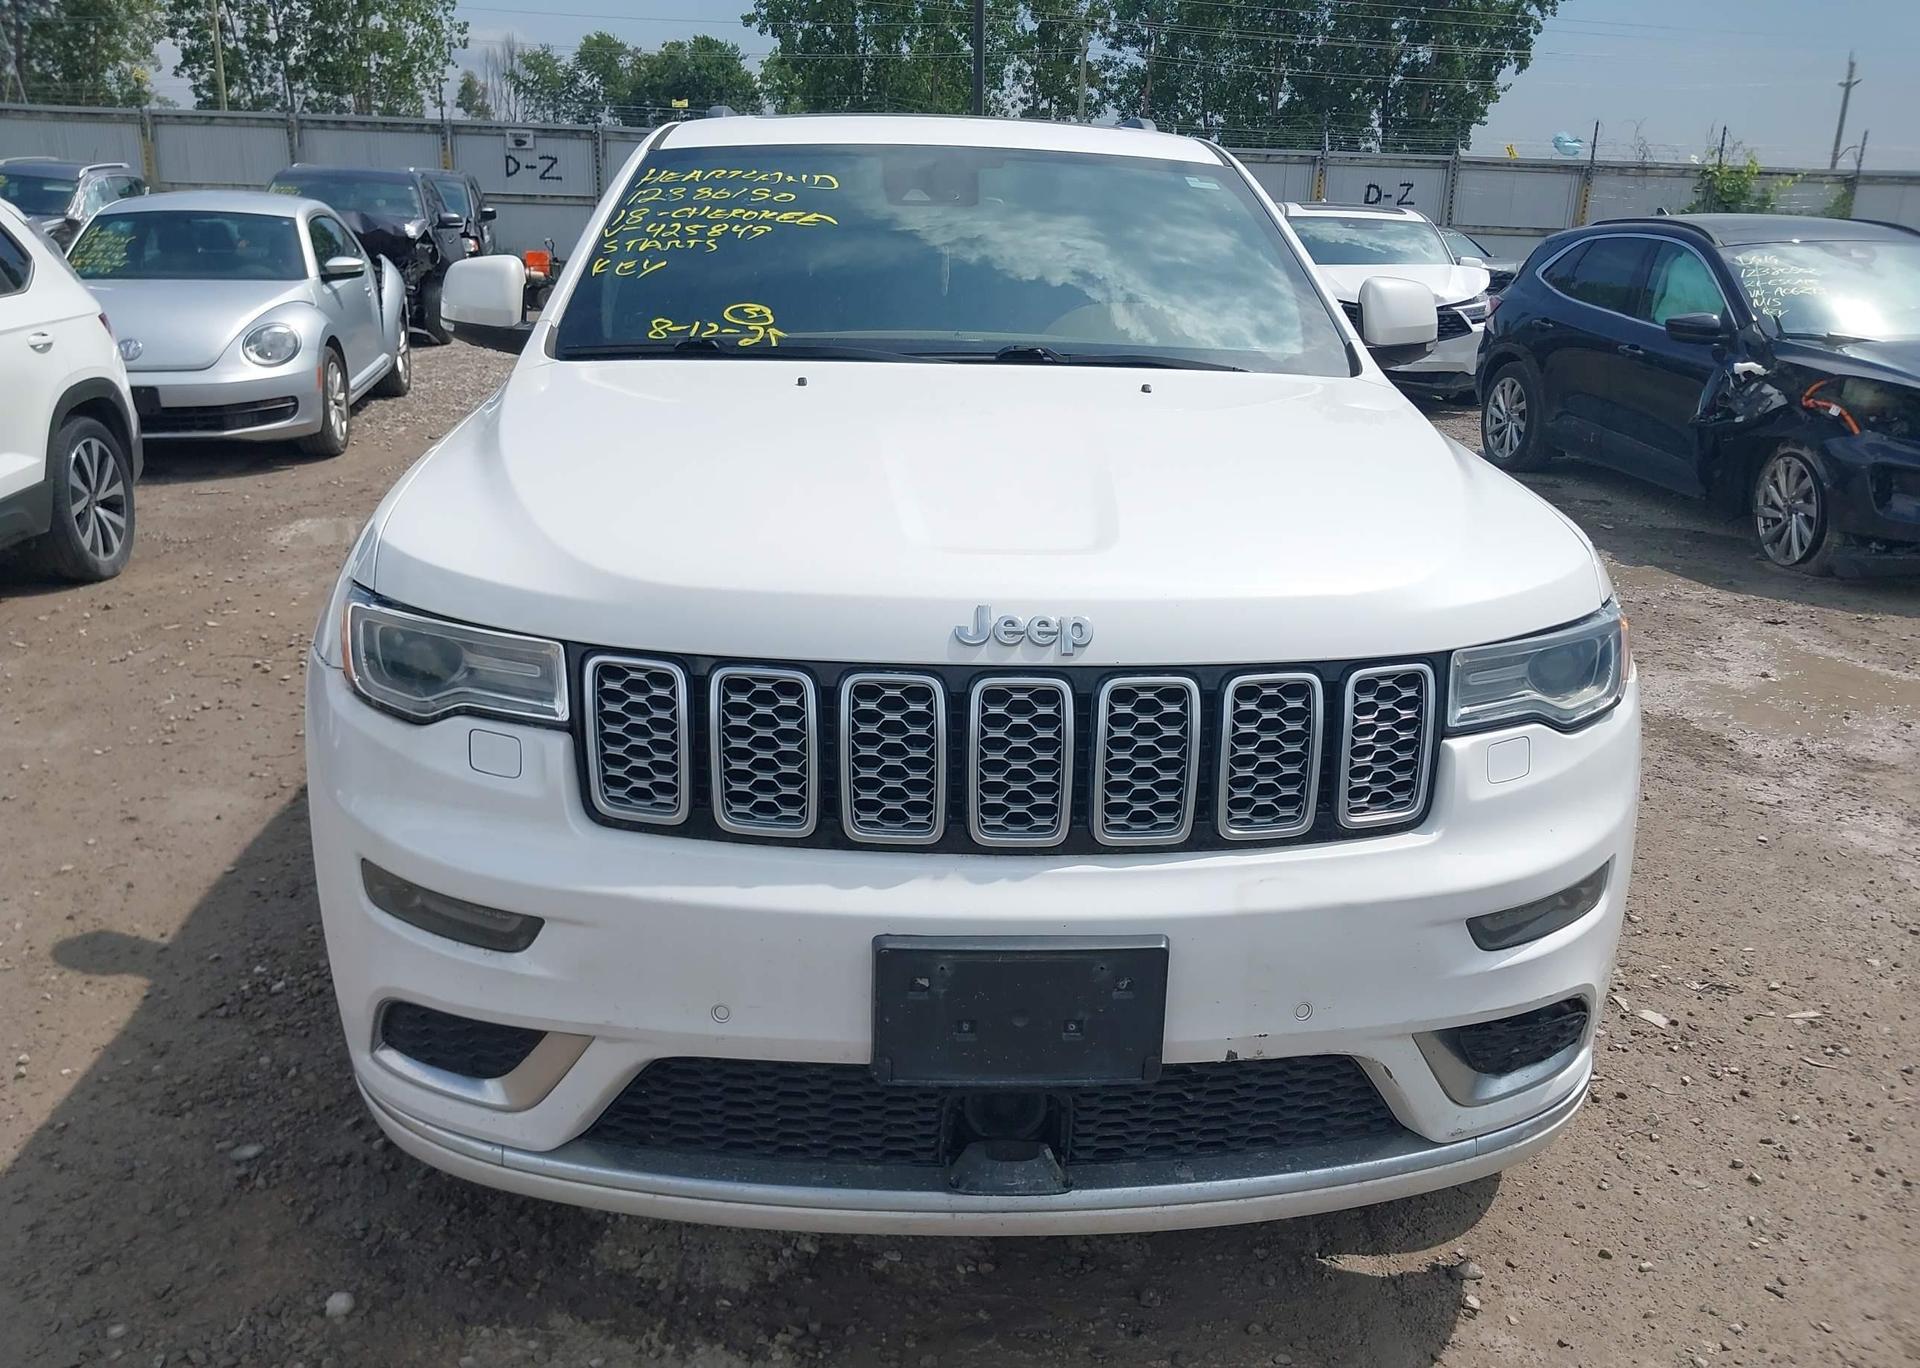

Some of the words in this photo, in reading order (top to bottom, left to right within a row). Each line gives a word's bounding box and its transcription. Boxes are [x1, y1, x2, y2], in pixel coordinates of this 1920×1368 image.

[505, 154, 563, 181] D-Z
[1364, 182, 1416, 206] D-Z
[603, 237, 719, 253] STARTS
[592, 258, 668, 278] KEY
[954, 604, 1094, 656] Jeep
